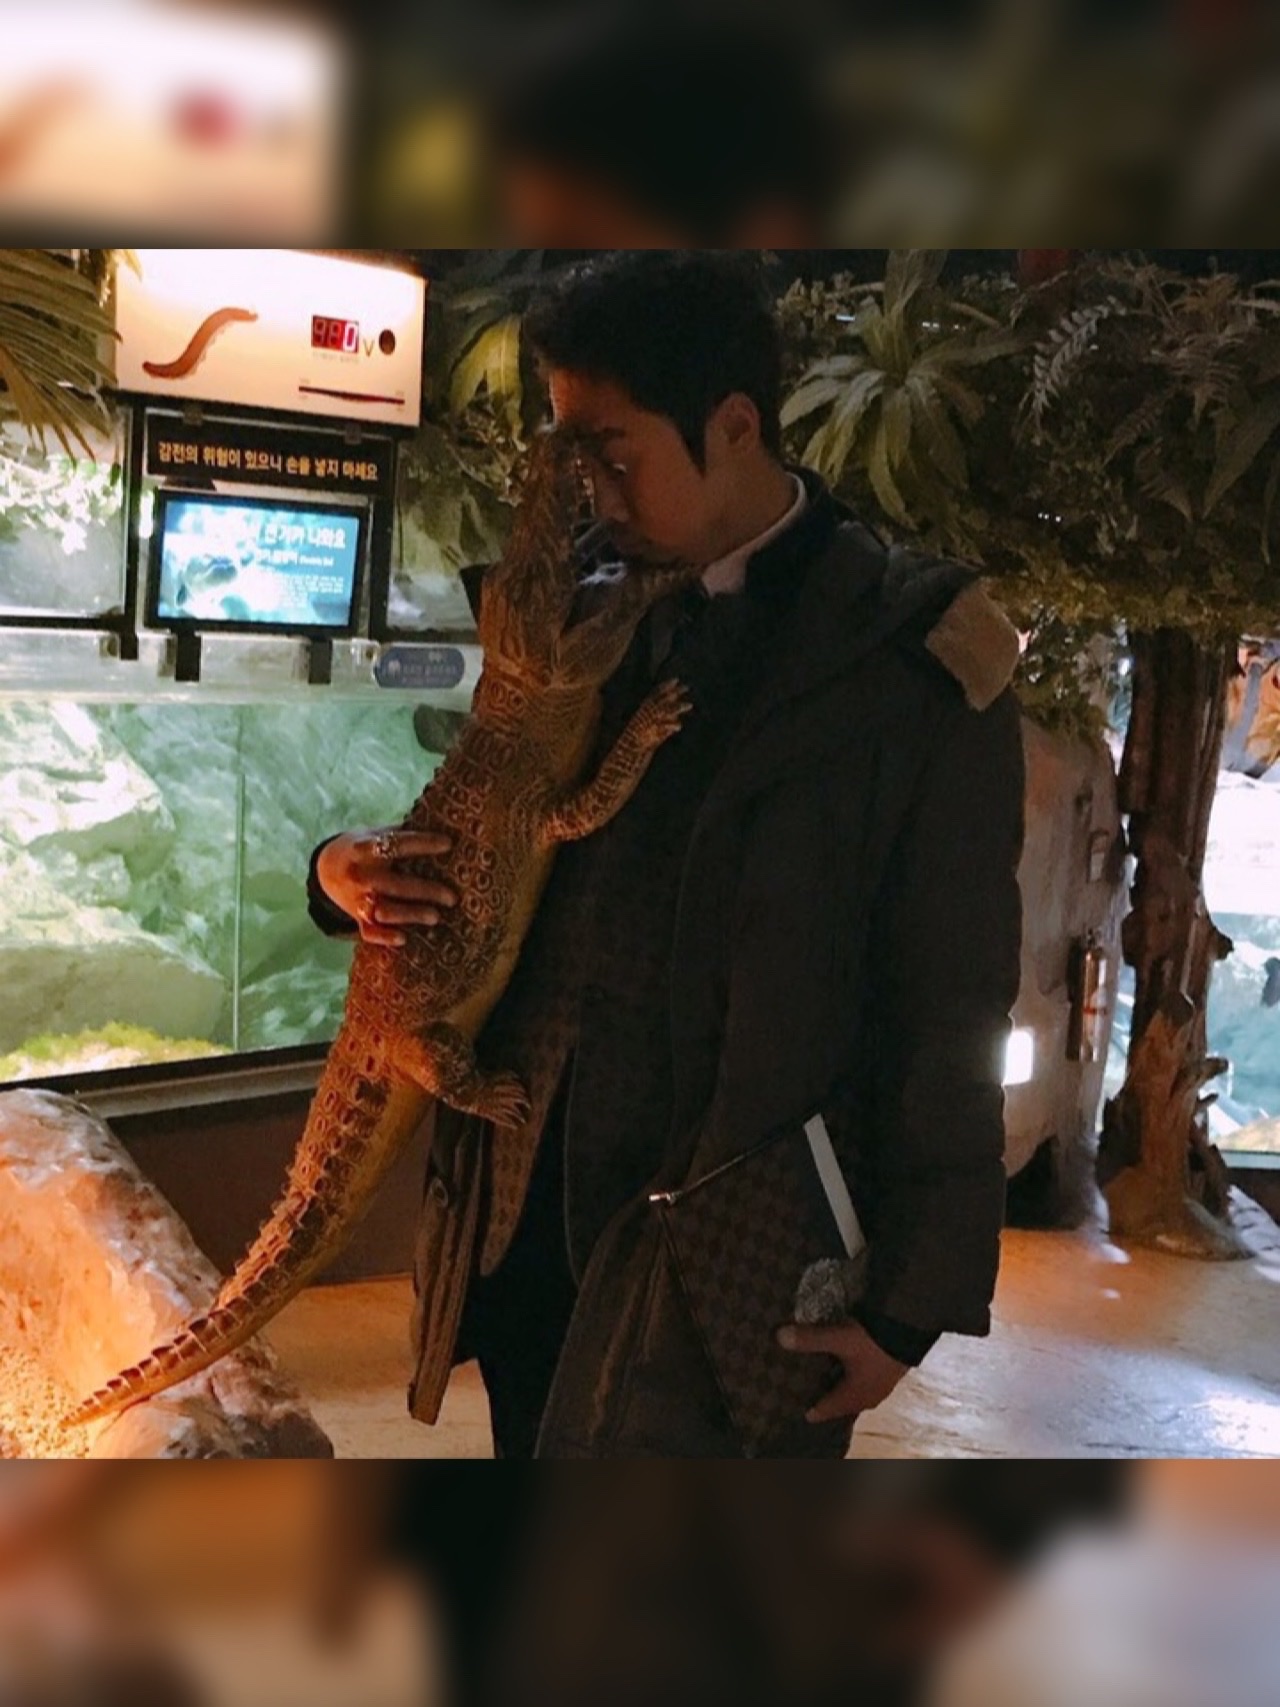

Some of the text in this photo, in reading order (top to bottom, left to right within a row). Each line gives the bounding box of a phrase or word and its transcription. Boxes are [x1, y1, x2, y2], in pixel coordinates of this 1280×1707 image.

[158, 440, 198, 464] 감전의
[202, 445, 241, 468] 위험이
[244, 450, 282, 473] 있으니
[286, 456, 310, 475] 손을
[342, 459, 378, 481] 마세요
